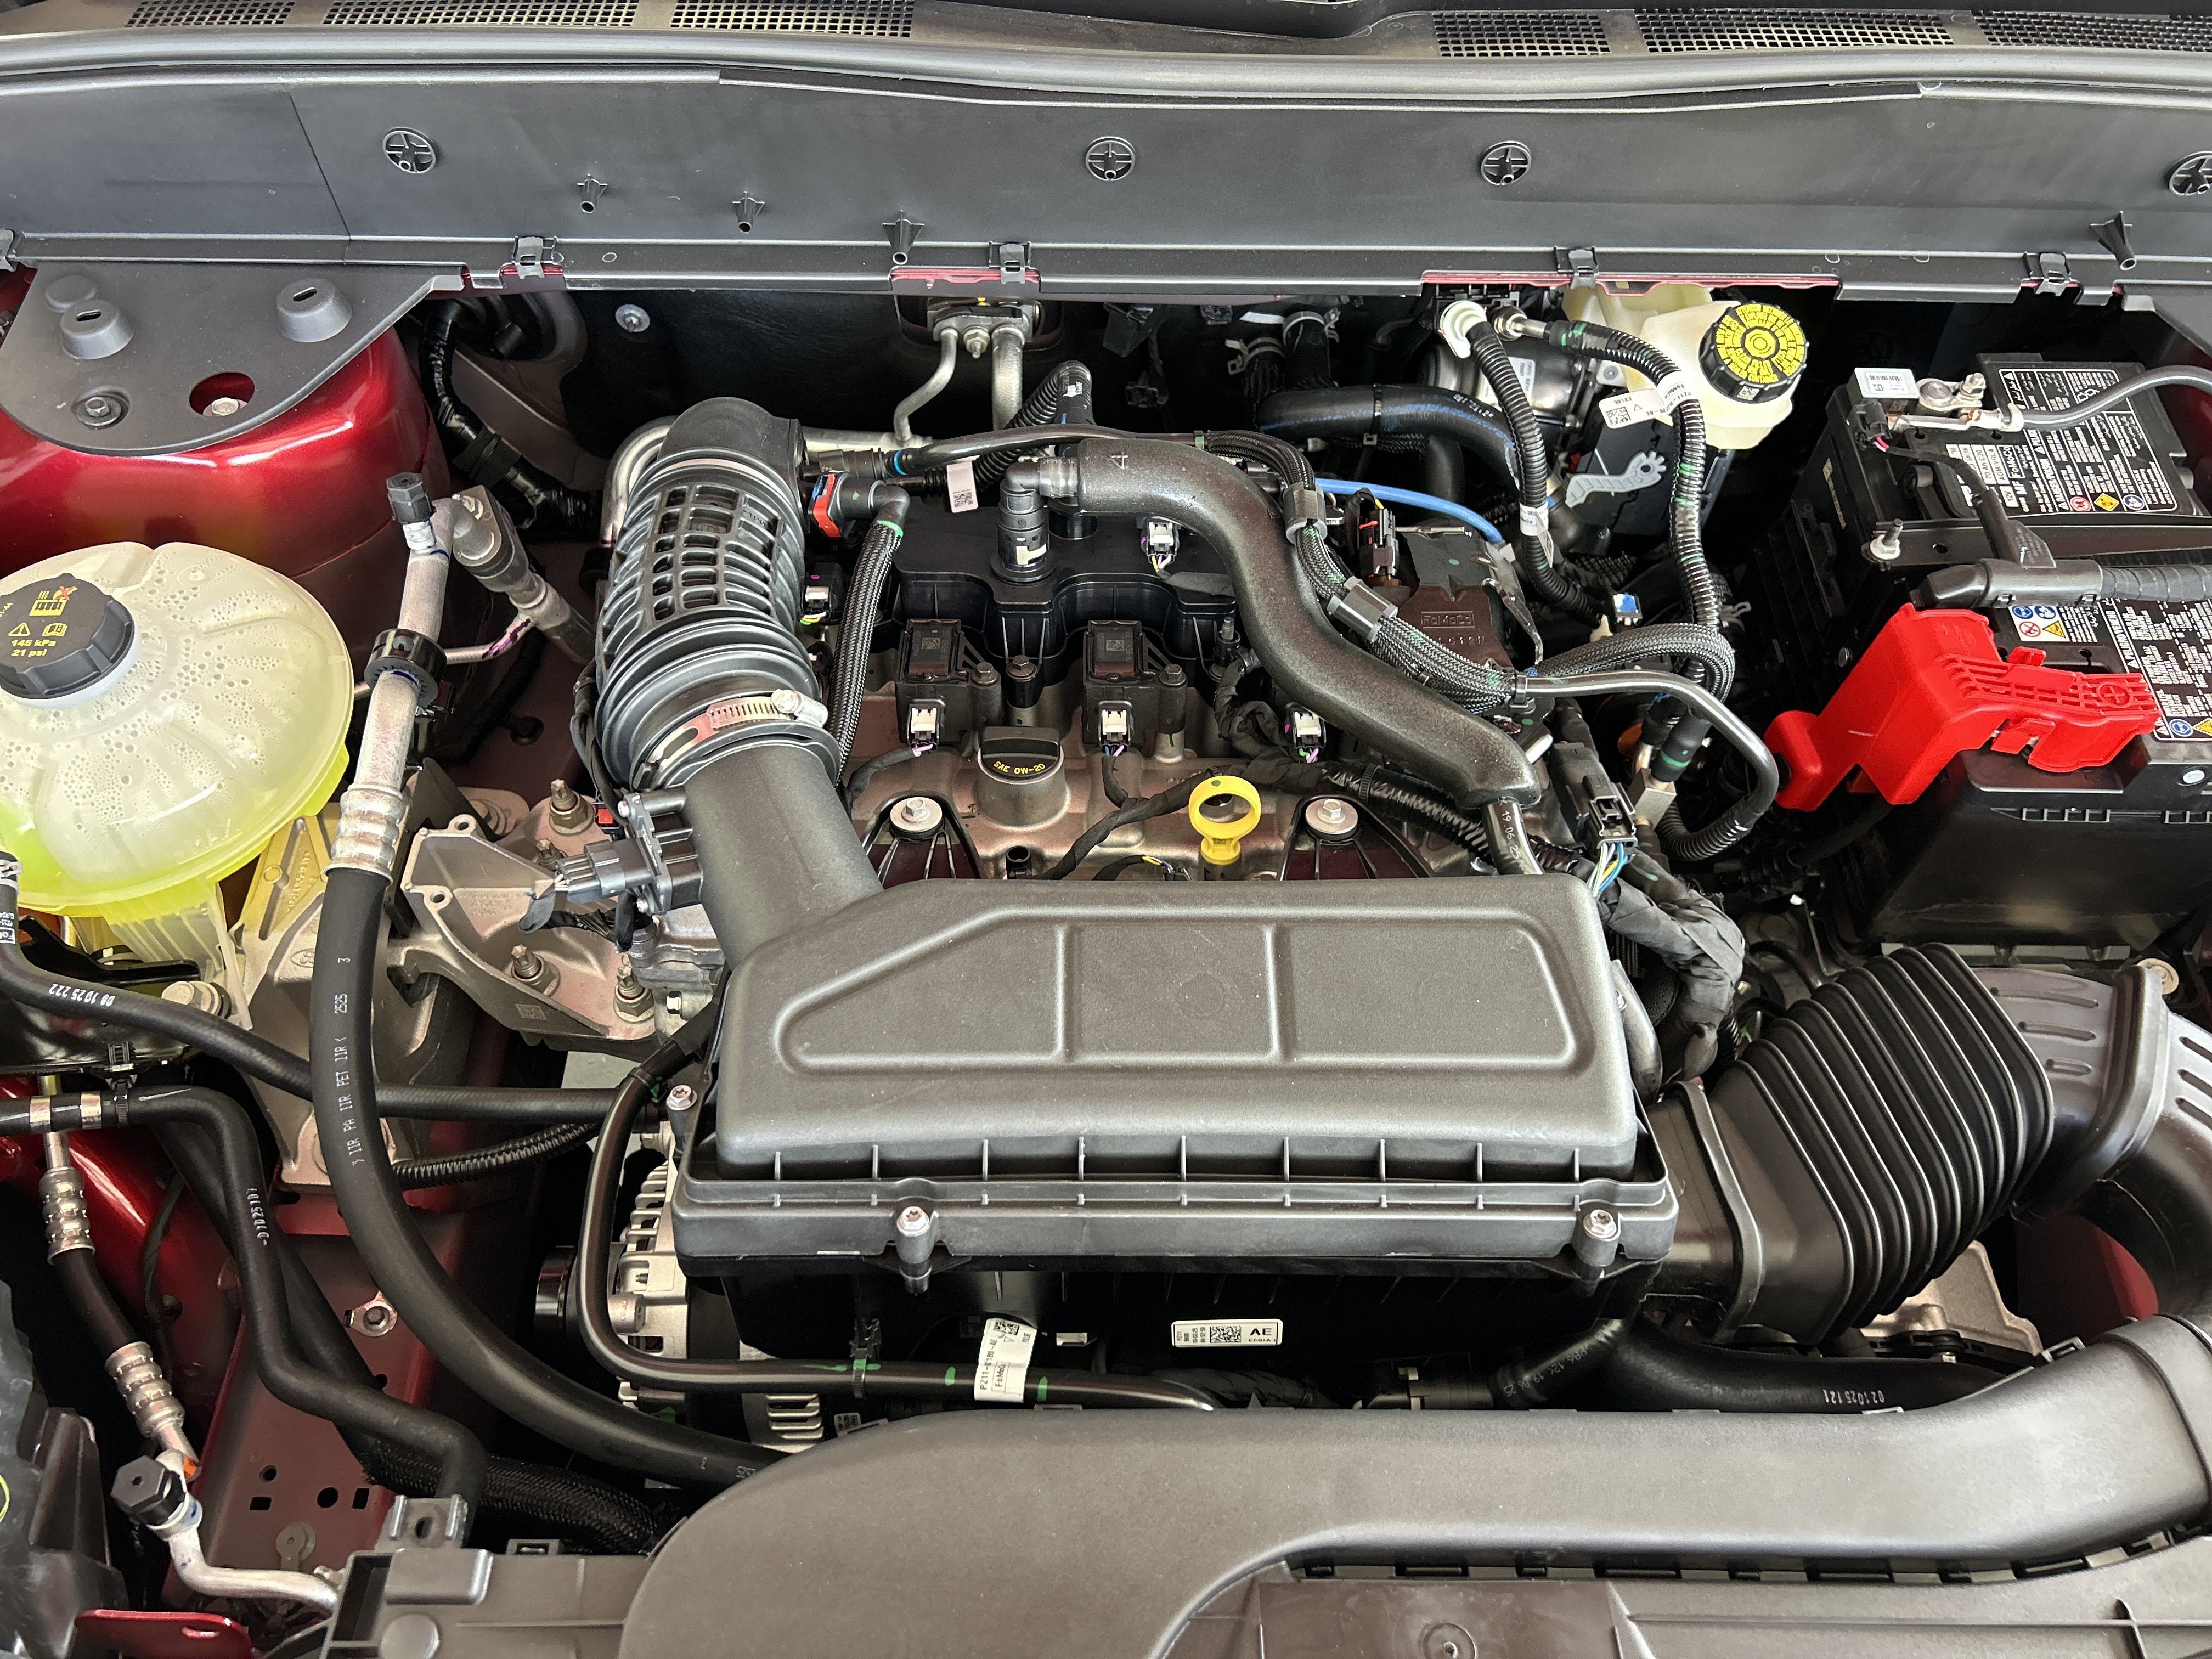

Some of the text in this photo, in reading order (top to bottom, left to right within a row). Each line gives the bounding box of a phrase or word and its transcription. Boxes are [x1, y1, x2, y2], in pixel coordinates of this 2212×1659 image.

[1975, 449, 1985, 460] C20
[2000, 445, 2021, 477] FoMoCo
[2011, 480, 2027, 494] MF
[2004, 490, 2014, 501] 12V
[2105, 610, 2133, 660] PELIGRO/VENENO
[28, 648, 47, 658] psi
[993, 761, 1046, 775] SAE 0W-20
[49, 984, 70, 997] 222
[334, 994, 348, 1014] 2525
[336, 1071, 350, 1087] PET
[1250, 1328, 1272, 1336] AE
